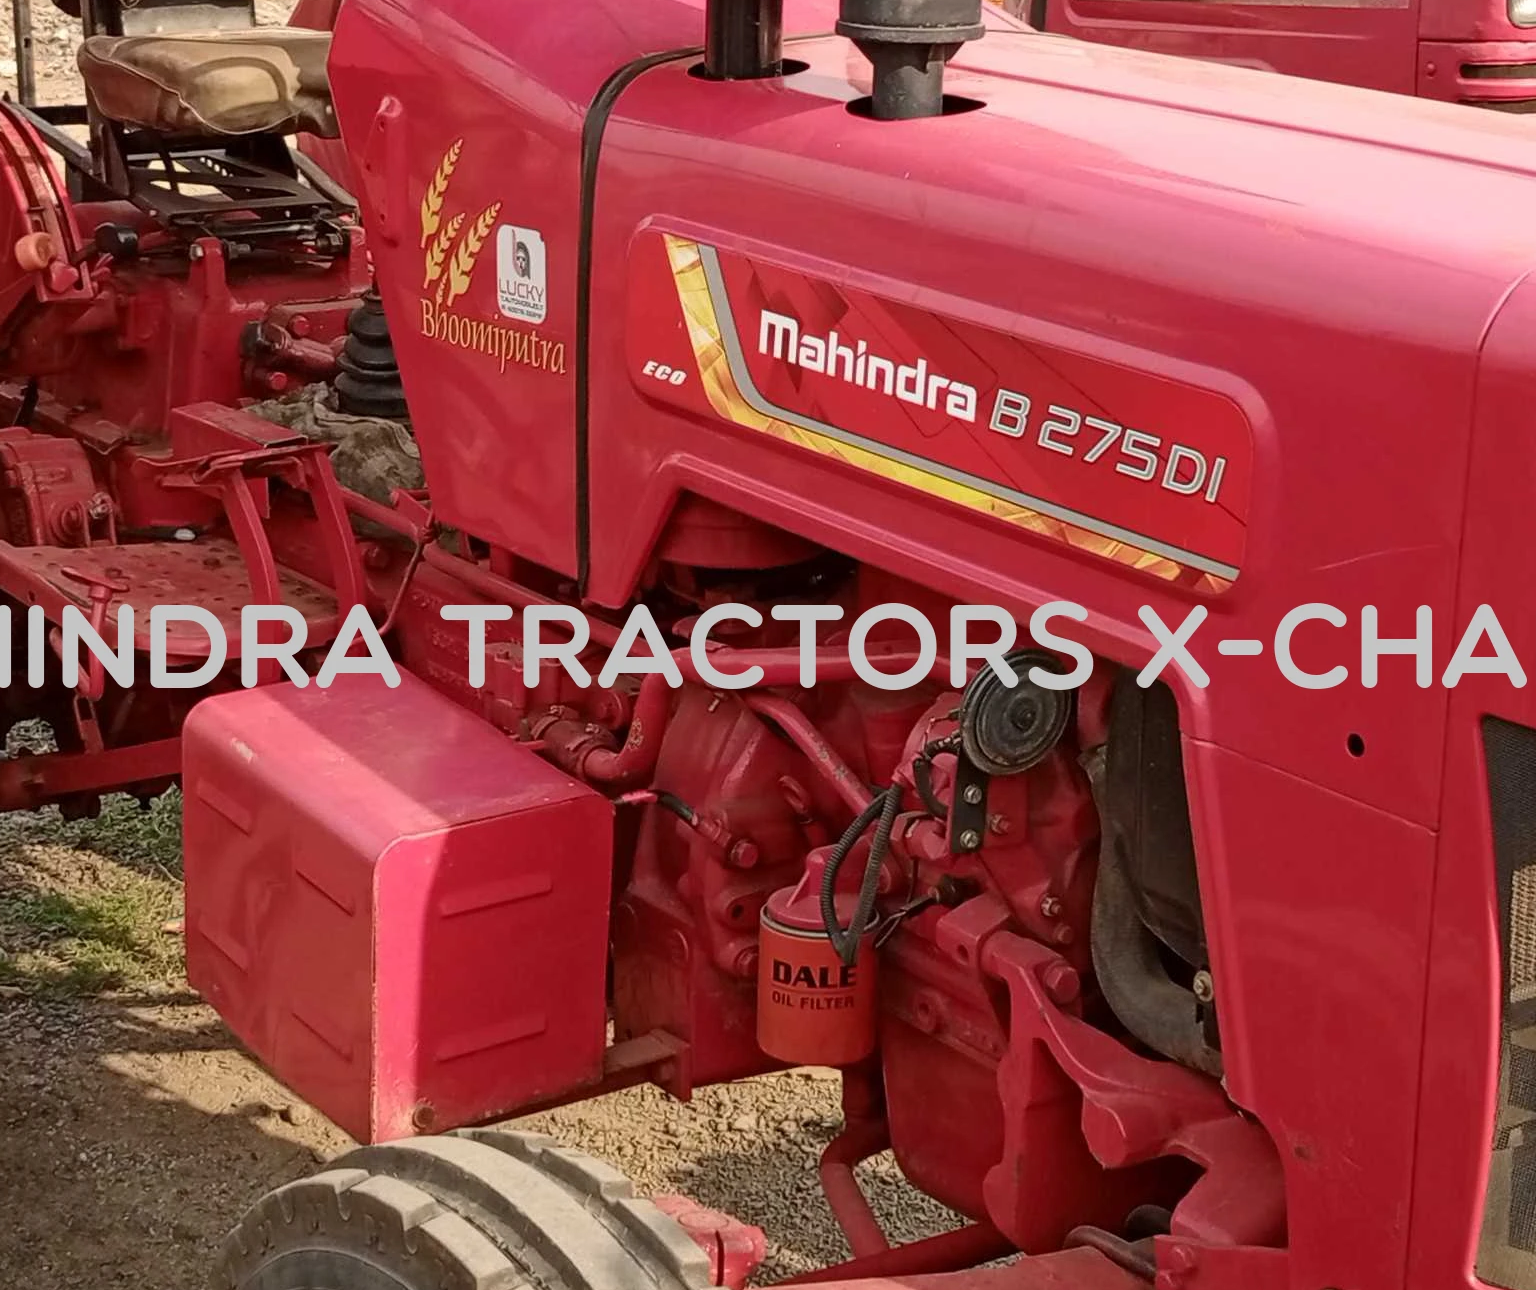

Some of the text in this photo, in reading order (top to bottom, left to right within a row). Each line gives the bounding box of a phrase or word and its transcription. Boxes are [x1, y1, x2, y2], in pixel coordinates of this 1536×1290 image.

[498, 278, 545, 302] LUCKY
[420, 298, 566, 374] Bhoomiputra
[642, 359, 687, 386] ECO
[758, 309, 978, 423] Mahindra
[772, 959, 857, 989] DALE
[772, 990, 854, 1010] OIL FILTER
